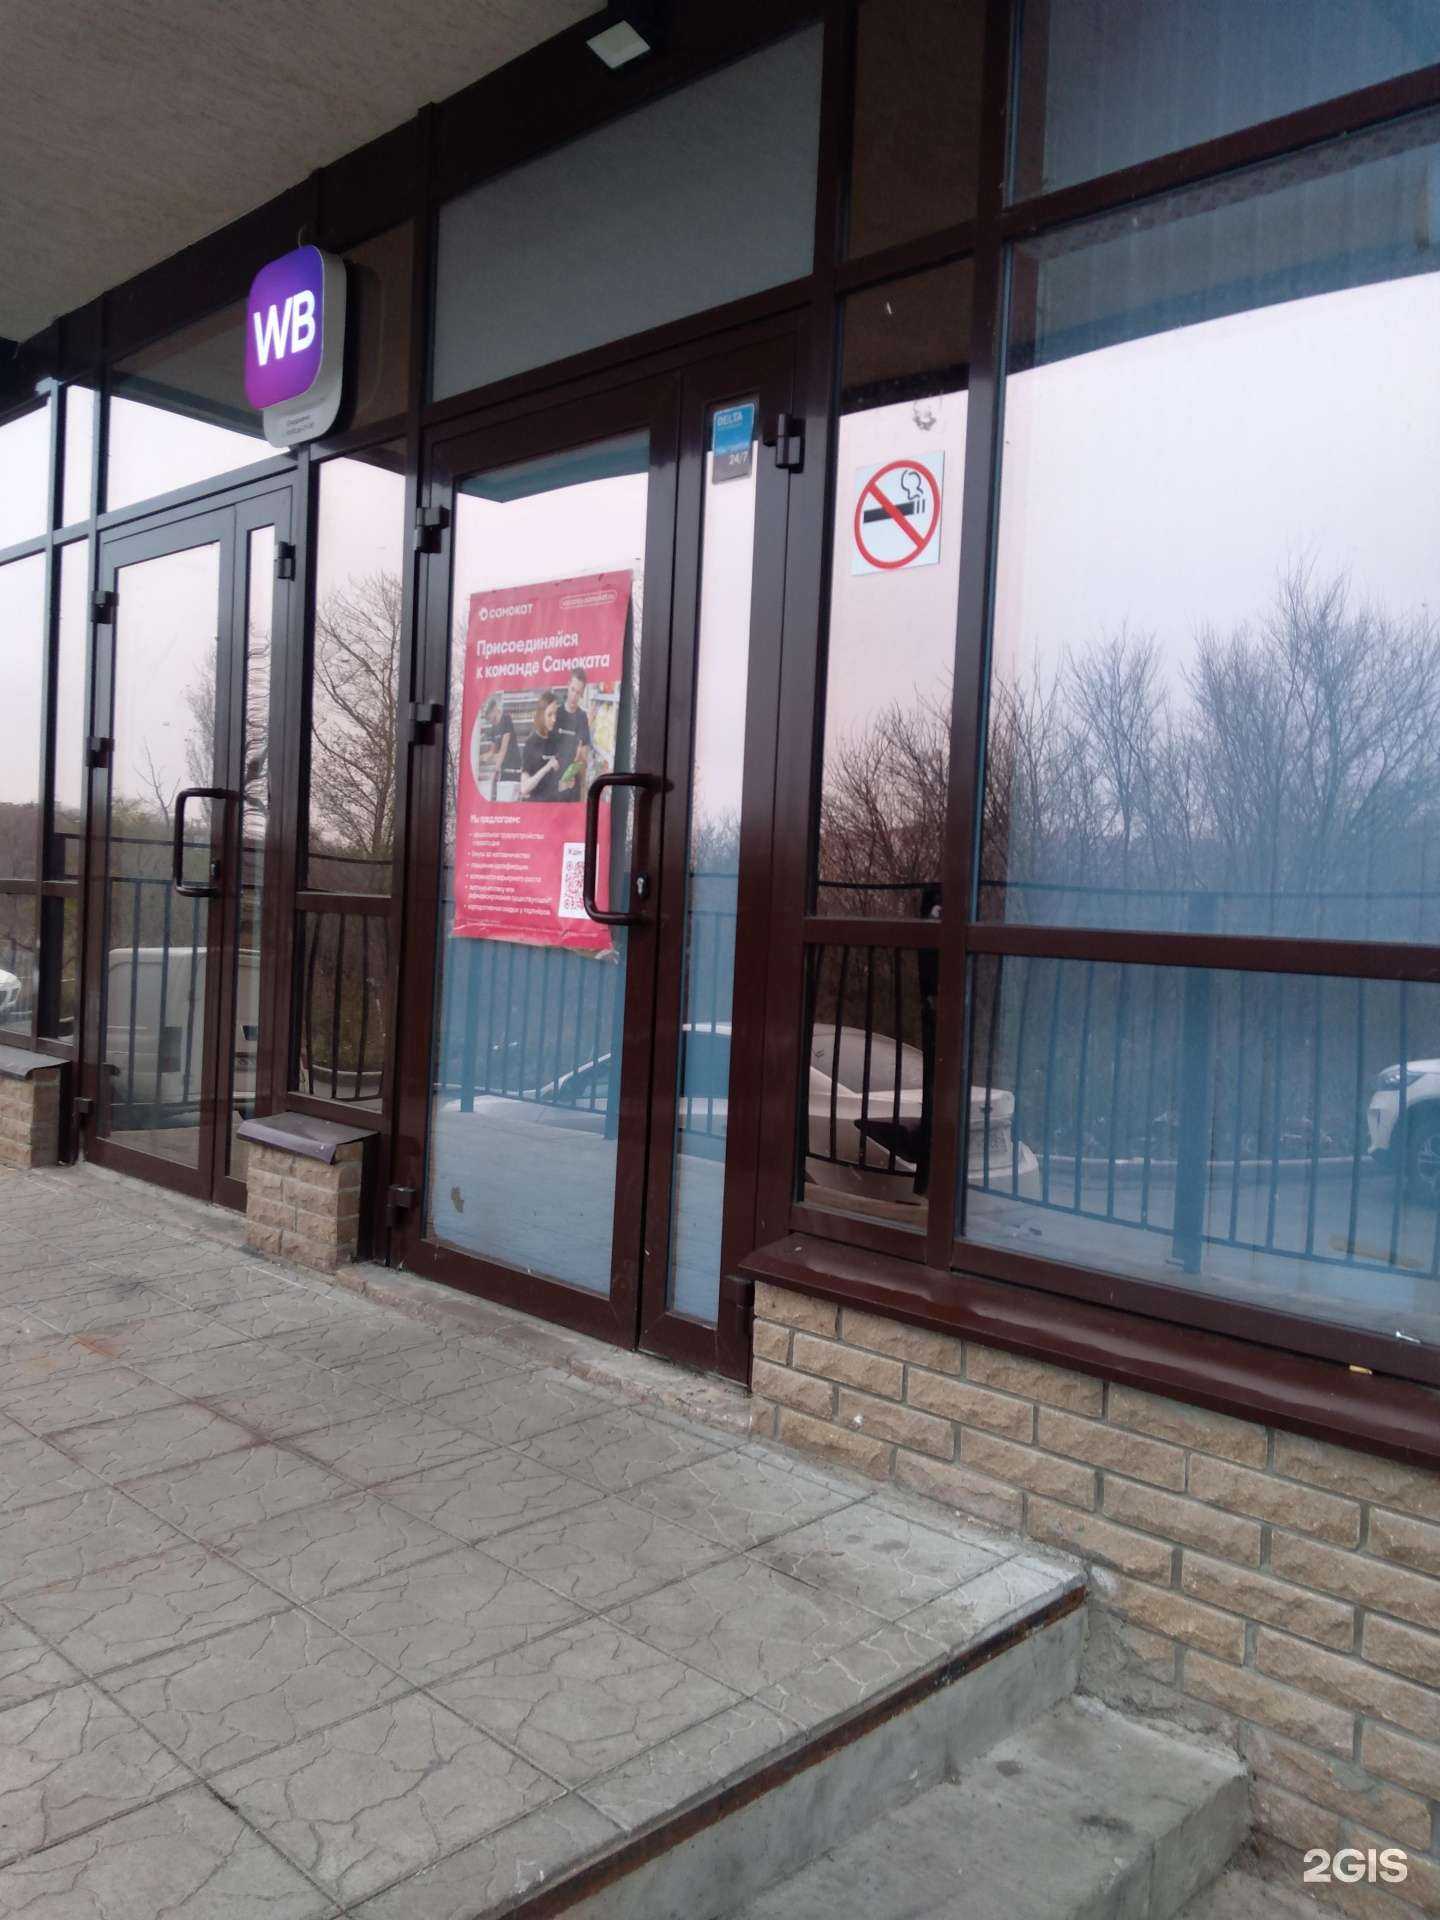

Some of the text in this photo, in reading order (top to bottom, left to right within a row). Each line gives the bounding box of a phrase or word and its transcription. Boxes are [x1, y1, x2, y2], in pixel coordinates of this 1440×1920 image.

[253, 289, 316, 366] WB
[717, 411, 743, 426] DELTA
[476, 630, 579, 660] Присоединяйся
[476, 654, 611, 680] к команде Самоката
